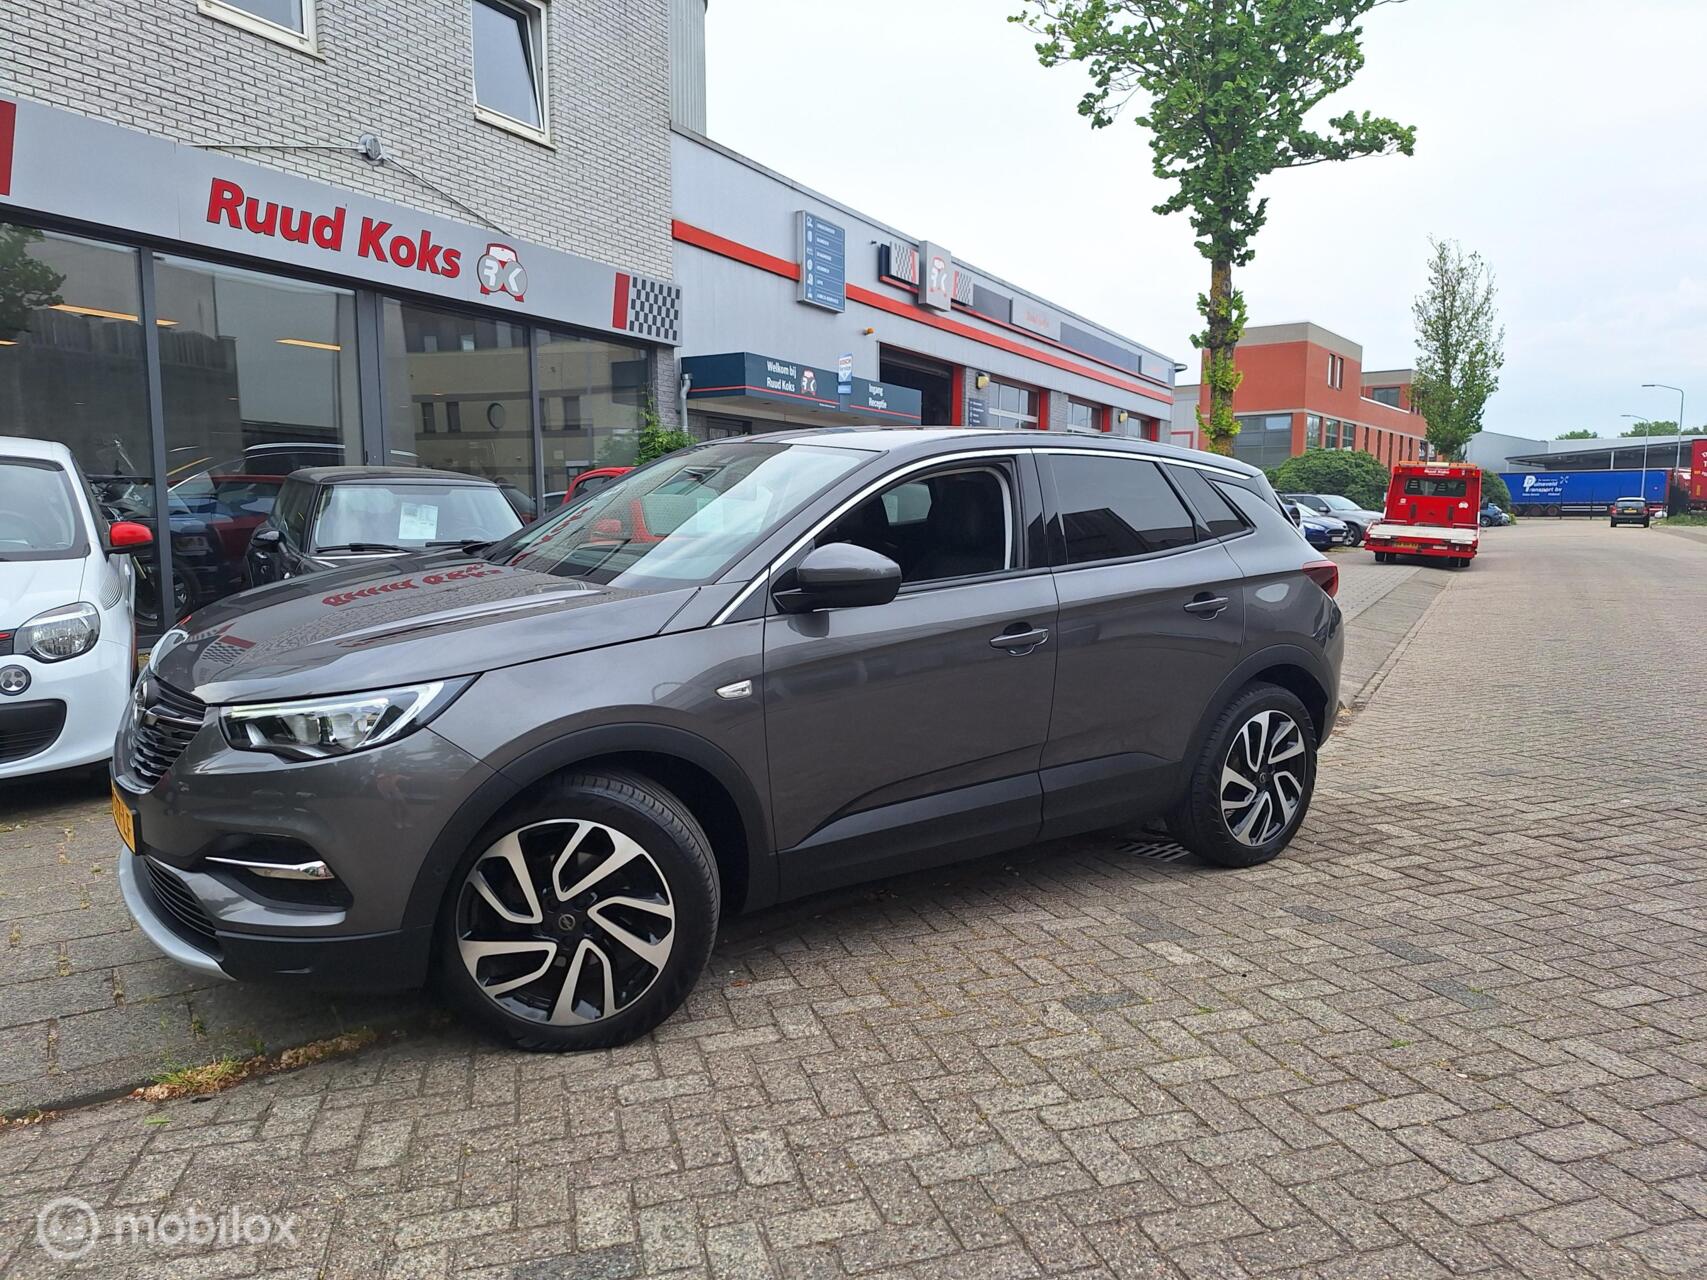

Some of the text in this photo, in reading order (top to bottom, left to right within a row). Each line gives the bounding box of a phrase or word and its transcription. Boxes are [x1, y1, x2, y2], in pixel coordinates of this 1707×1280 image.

[207, 177, 462, 279] Ruud Koks
[766, 360, 797, 379] Welkom bij
[766, 376, 796, 393] Ruud Koks
[868, 383, 884, 397] Ingang
[868, 396, 888, 410] Receptie
